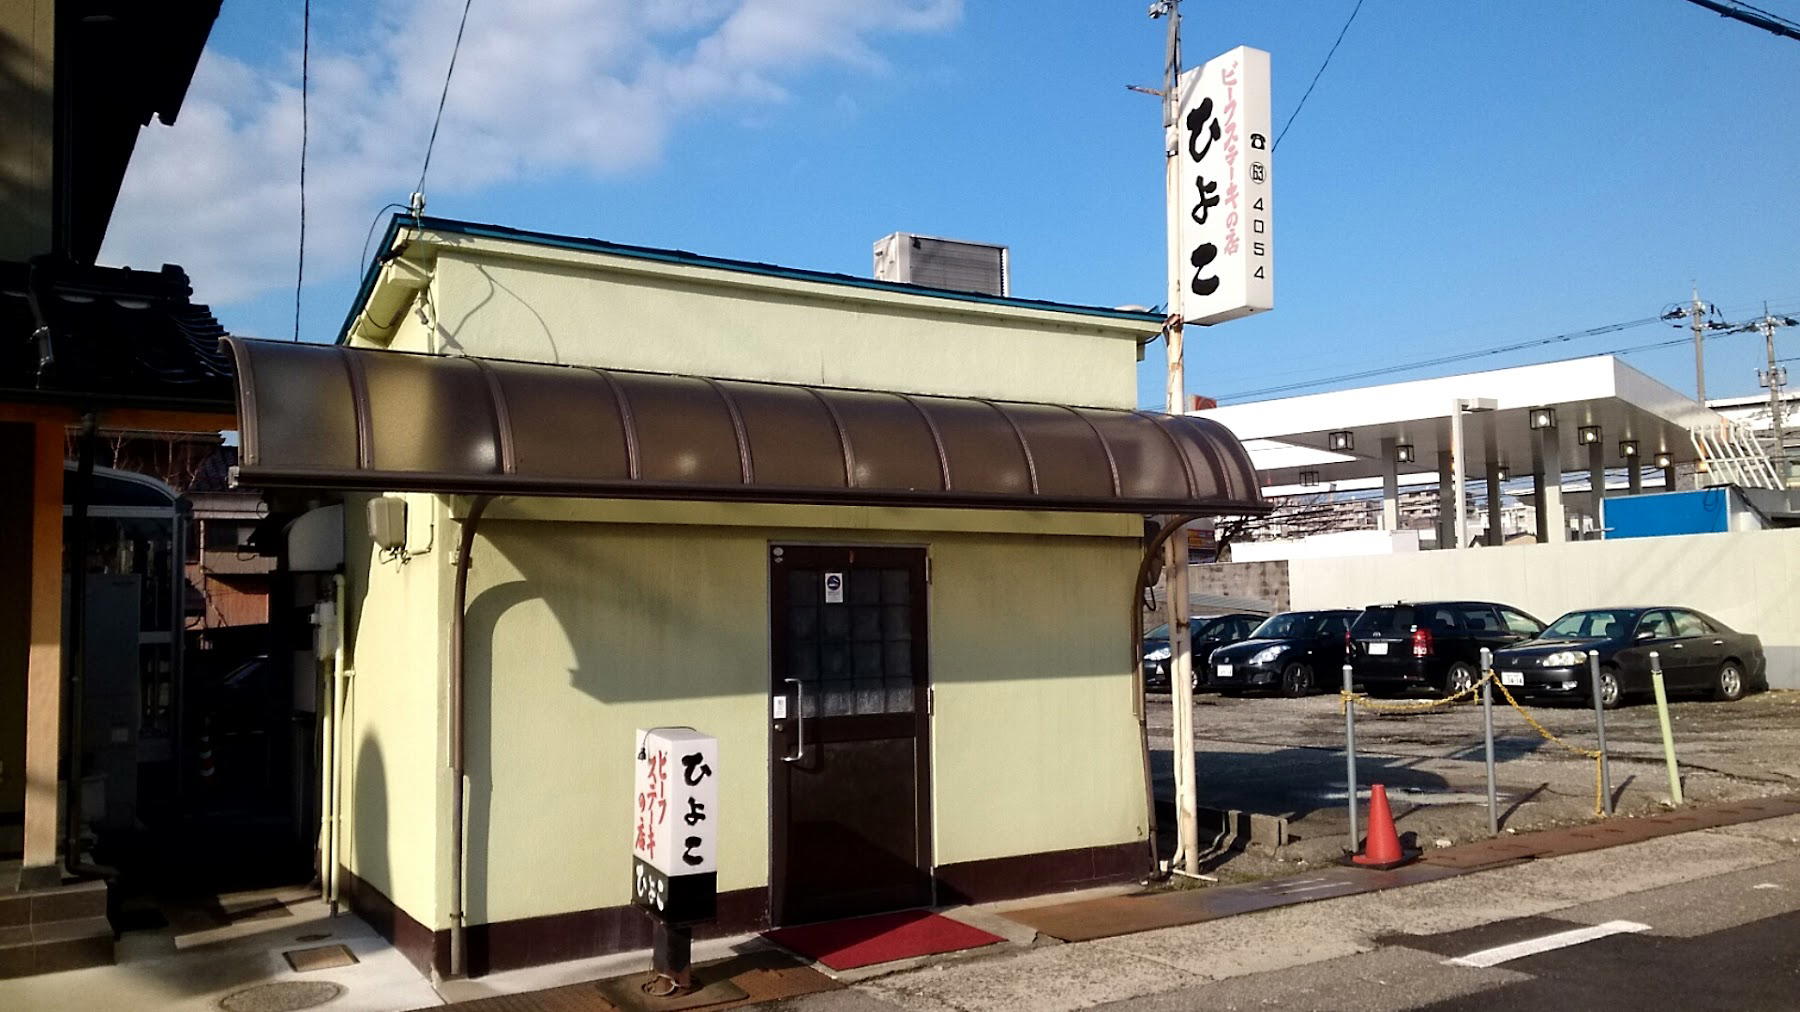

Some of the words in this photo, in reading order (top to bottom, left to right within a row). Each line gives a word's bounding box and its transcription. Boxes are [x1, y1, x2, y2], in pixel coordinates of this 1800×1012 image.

[1186, 97, 1221, 296] ひよこ
[1222, 61, 1239, 256] ビーフステーキの店
[681, 752, 712, 866] ひよこ
